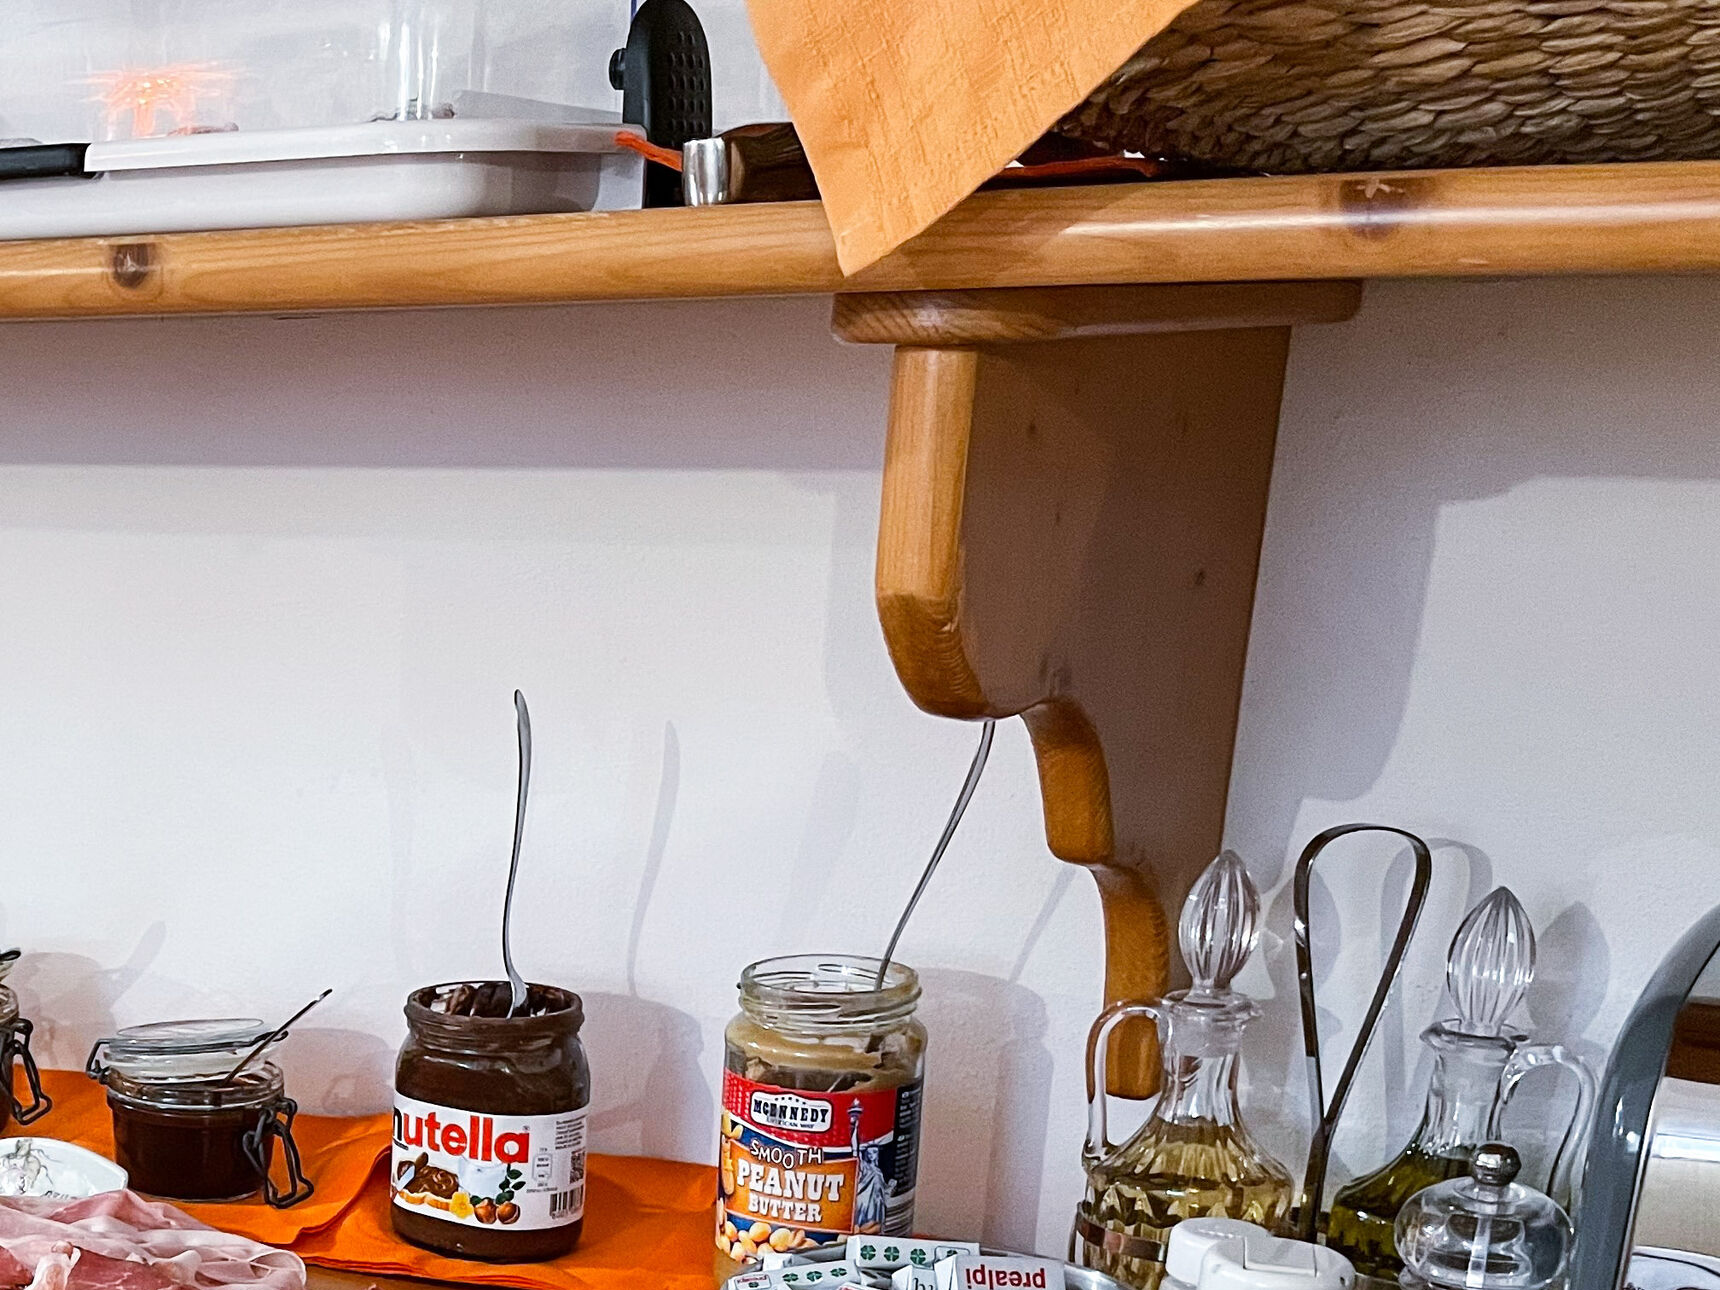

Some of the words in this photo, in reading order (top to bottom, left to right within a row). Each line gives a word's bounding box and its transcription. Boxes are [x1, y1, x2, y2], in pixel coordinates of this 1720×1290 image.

[751, 1139, 822, 1170] SMOOTH
[736, 1159, 845, 1202] PEANUT
[748, 1196, 823, 1223] BUTTER
[965, 1264, 1047, 1290] prealpi
